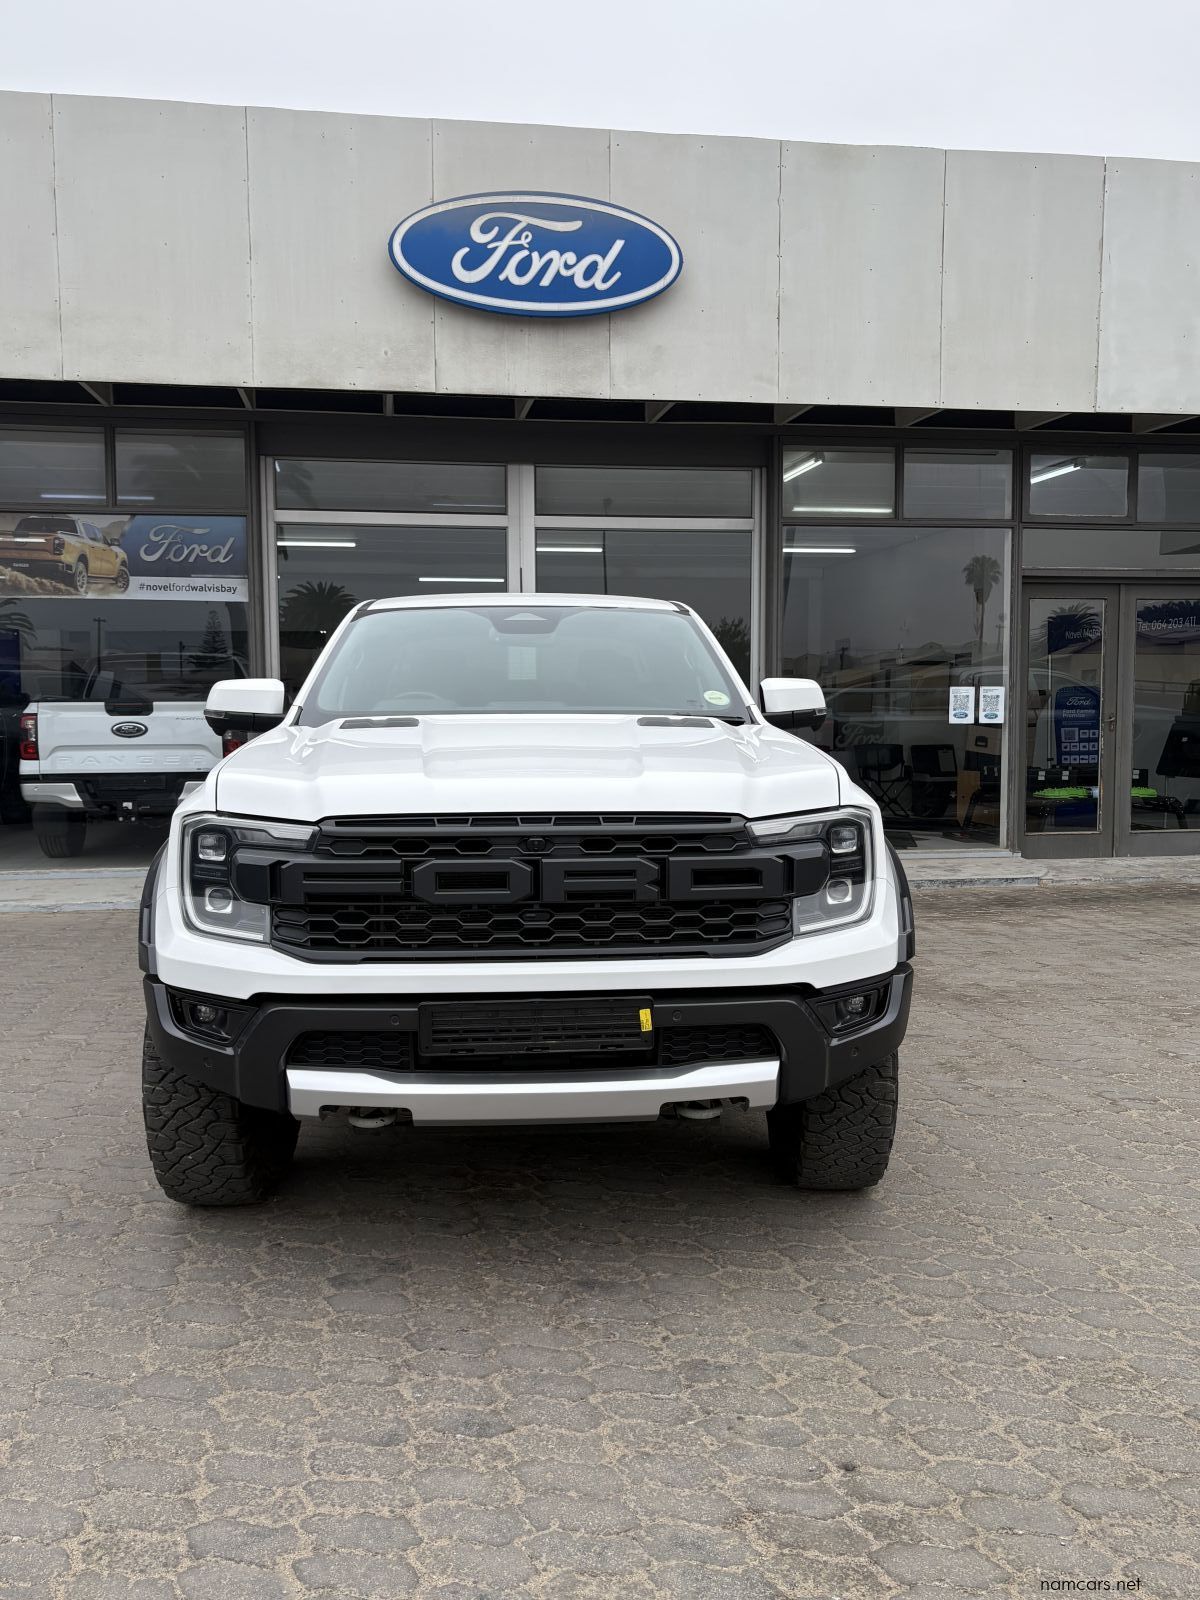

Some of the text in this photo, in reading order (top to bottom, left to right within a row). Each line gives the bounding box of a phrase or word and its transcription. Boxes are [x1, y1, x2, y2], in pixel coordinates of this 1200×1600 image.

[451, 211, 625, 291] Ford
[139, 524, 235, 563] Ford
[139, 583, 238, 594] #novelfordwalvisbay
[1151, 619, 1166, 631] 064
[1167, 617, 1183, 629] 203
[1066, 696, 1092, 706] Ford
[56, 755, 206, 769] RANGER
[280, 857, 786, 906] FORD
